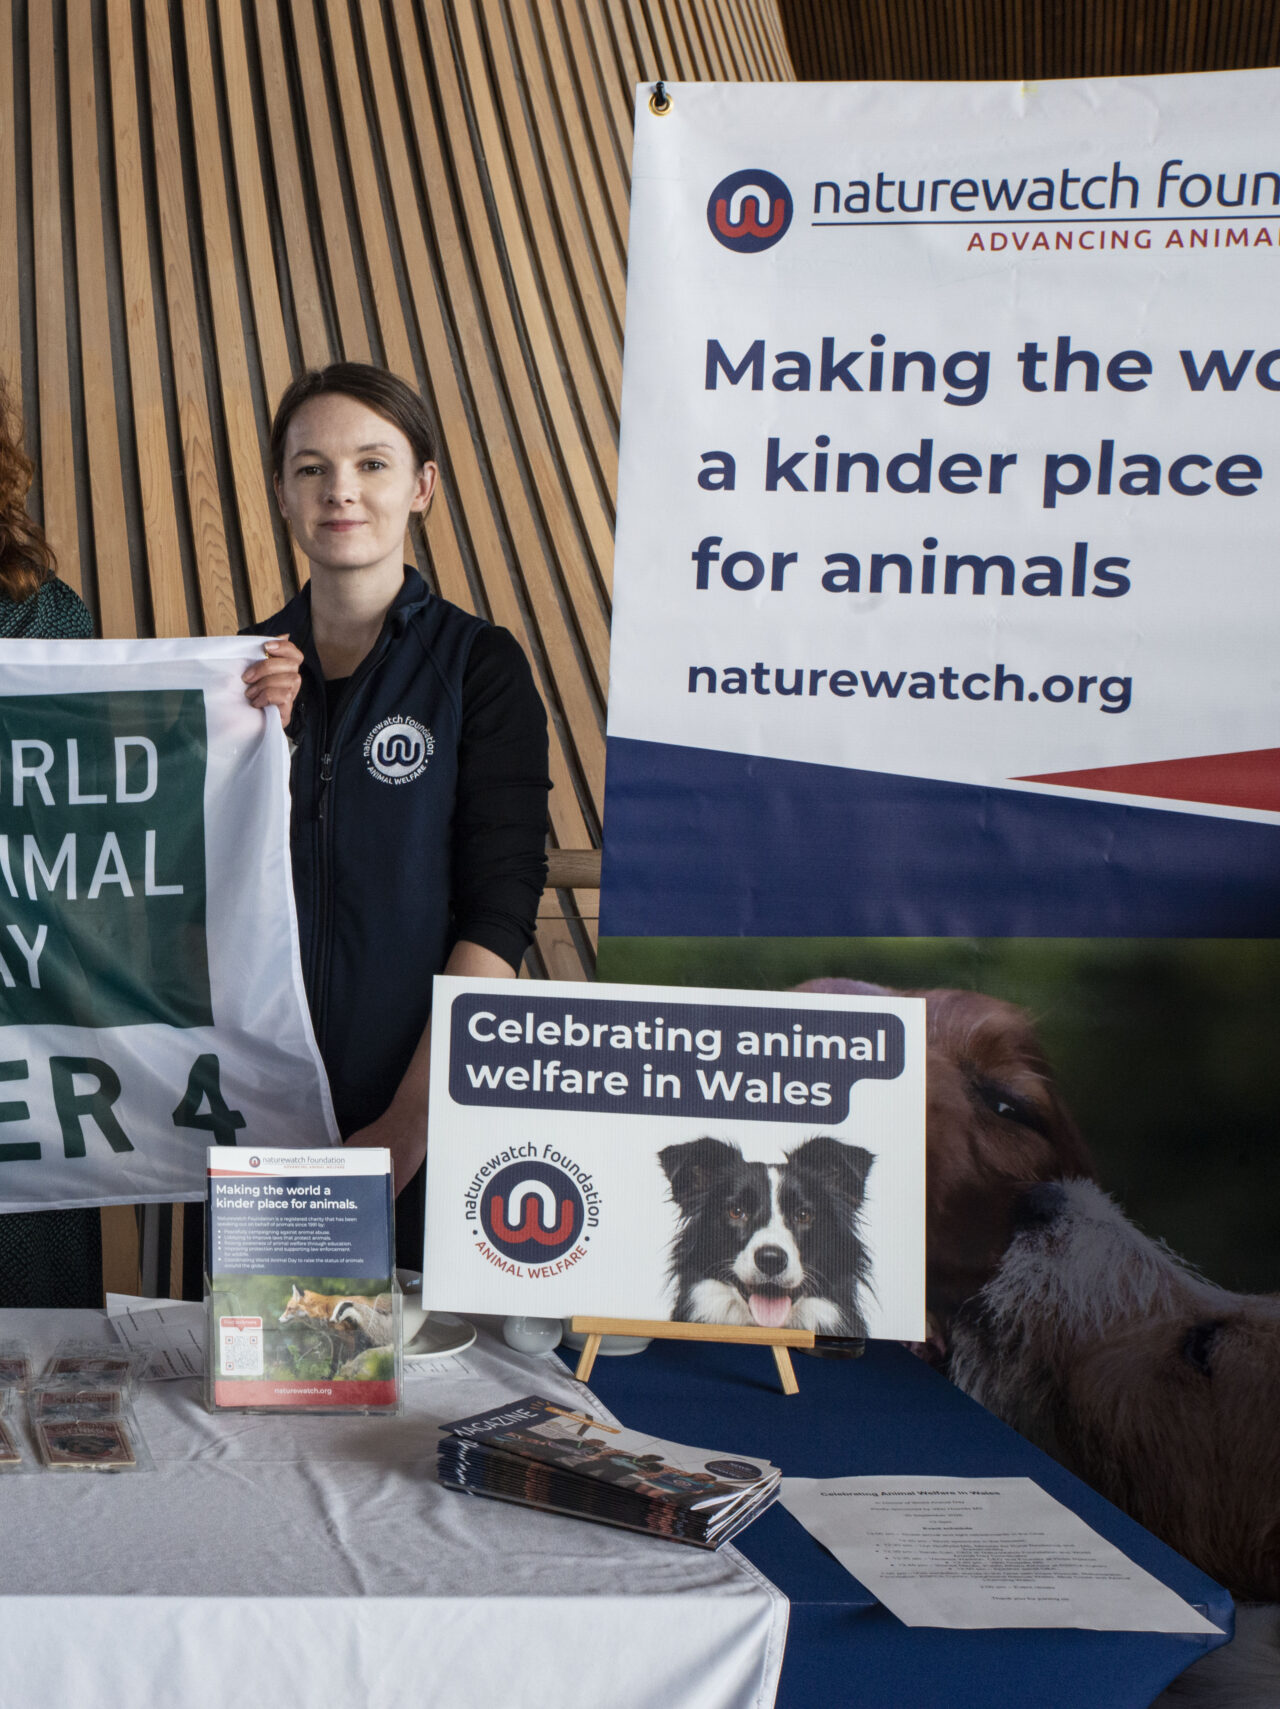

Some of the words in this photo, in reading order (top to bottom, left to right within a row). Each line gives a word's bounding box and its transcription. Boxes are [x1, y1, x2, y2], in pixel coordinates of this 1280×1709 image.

[812, 161, 1139, 214] naturewatch
[1157, 158, 1280, 209] foun
[966, 229, 1152, 252] ADVANCING
[1165, 227, 1280, 249] ANIMA
[703, 334, 991, 407] Making
[1017, 335, 1153, 393] the
[1179, 348, 1280, 392] wo
[696, 448, 738, 492] a
[764, 435, 1018, 496] kinder
[1042, 439, 1264, 509] place
[691, 536, 798, 592] for
[820, 537, 1132, 598] animals
[687, 663, 1133, 714] naturewatch.org
[363, 714, 403, 757] naturewatch
[405, 716, 436, 756] foundation
[367, 766, 393, 785] ANIMAL
[394, 764, 427, 786] WELFARE
[467, 1011, 723, 1060] Celebrating
[737, 1025, 887, 1062] animal
[172, 1053, 247, 1146] 4
[465, 1059, 629, 1097] welfare
[643, 1064, 682, 1099] in
[696, 1069, 833, 1107] Wales
[262, 1155, 306, 1164] naturewatch
[307, 1155, 346, 1164] foundation
[216, 1184, 260, 1197] Making
[263, 1185, 284, 1196] the
[287, 1185, 321, 1196] world
[324, 1187, 331, 1196] a
[216, 1198, 255, 1209] kinder
[258, 1198, 288, 1212] place
[291, 1198, 308, 1209] for
[310, 1199, 358, 1210] animals.
[464, 1141, 538, 1220] naturewatch
[542, 1144, 603, 1228] foundation
[475, 1241, 524, 1278] ANIMAL
[527, 1245, 588, 1279] WELFARE
[274, 1387, 332, 1396] naturewatch.org
